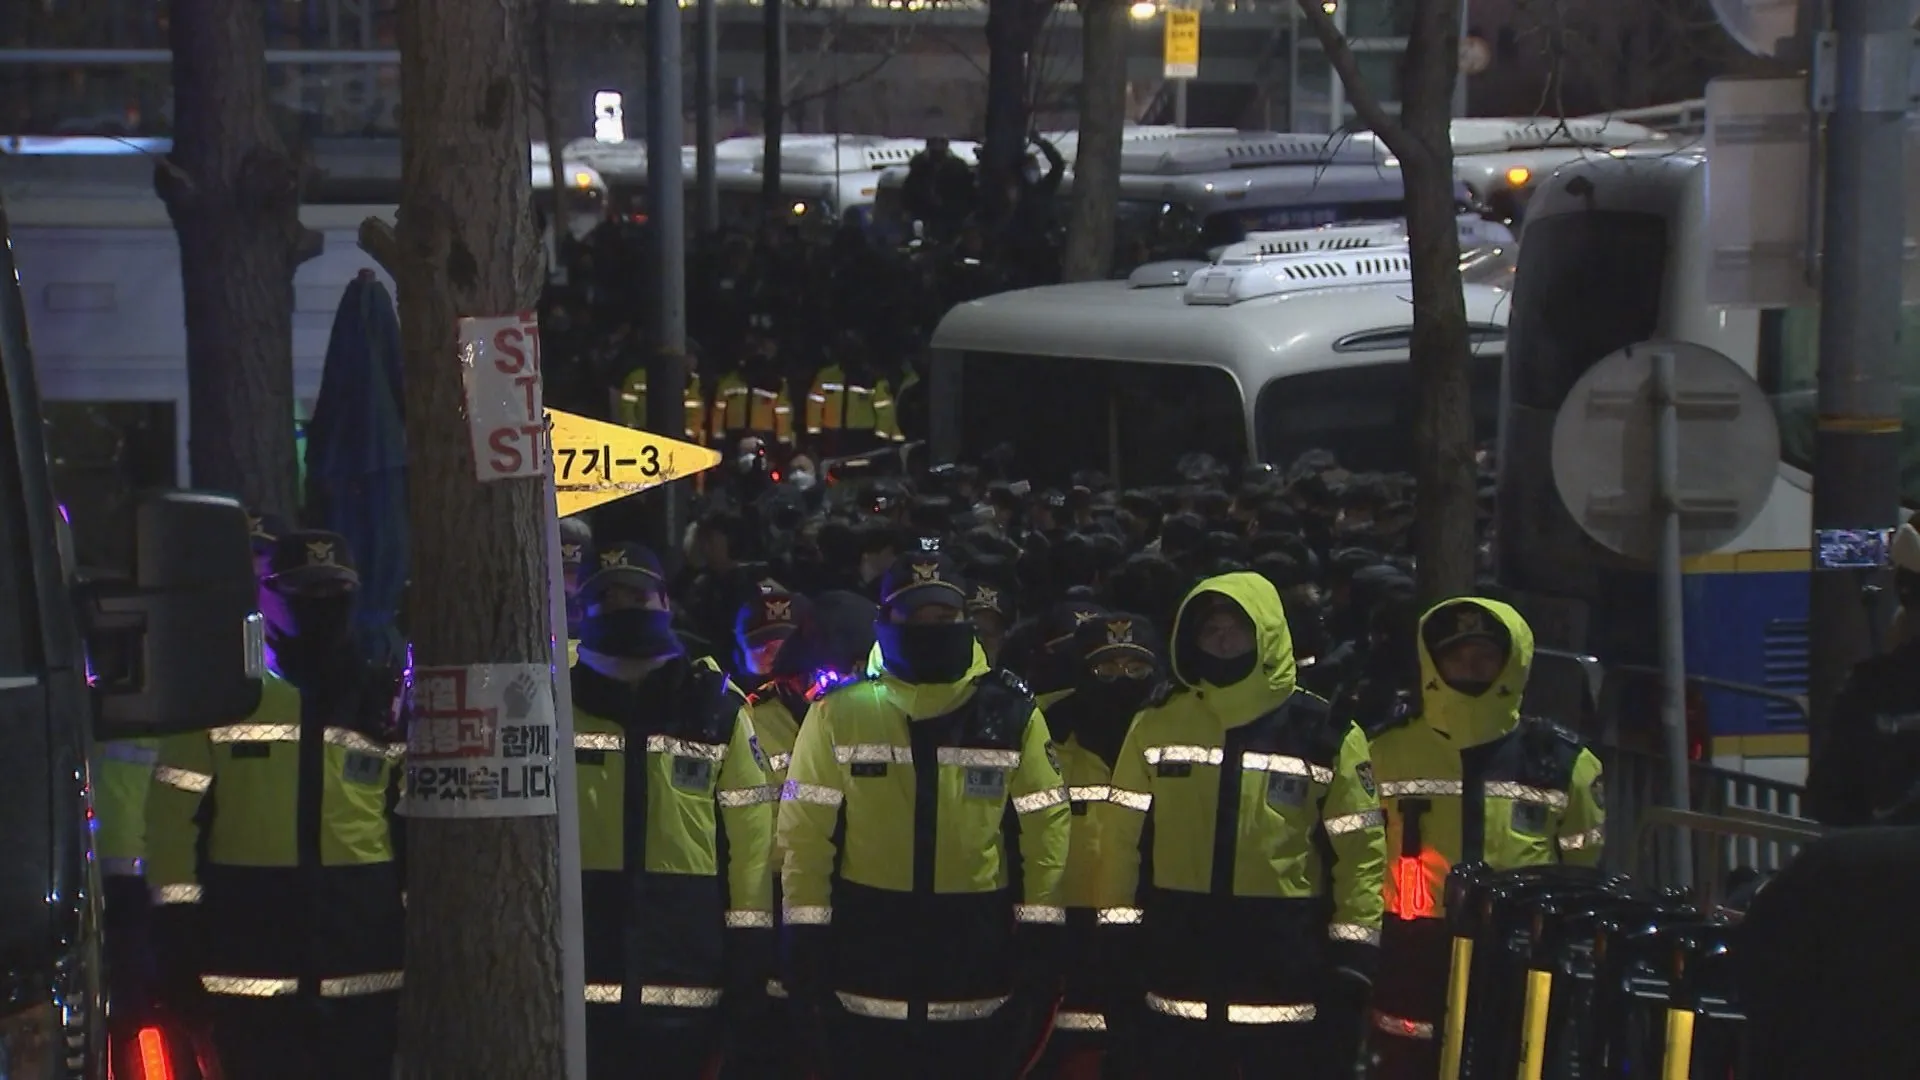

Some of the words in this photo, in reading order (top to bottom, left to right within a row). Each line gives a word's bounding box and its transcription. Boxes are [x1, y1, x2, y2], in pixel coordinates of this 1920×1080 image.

[515, 376, 538, 421] T
[489, 425, 542, 473] ST
[552, 445, 660, 480] 7기-3
[501, 725, 550, 757] 함께
